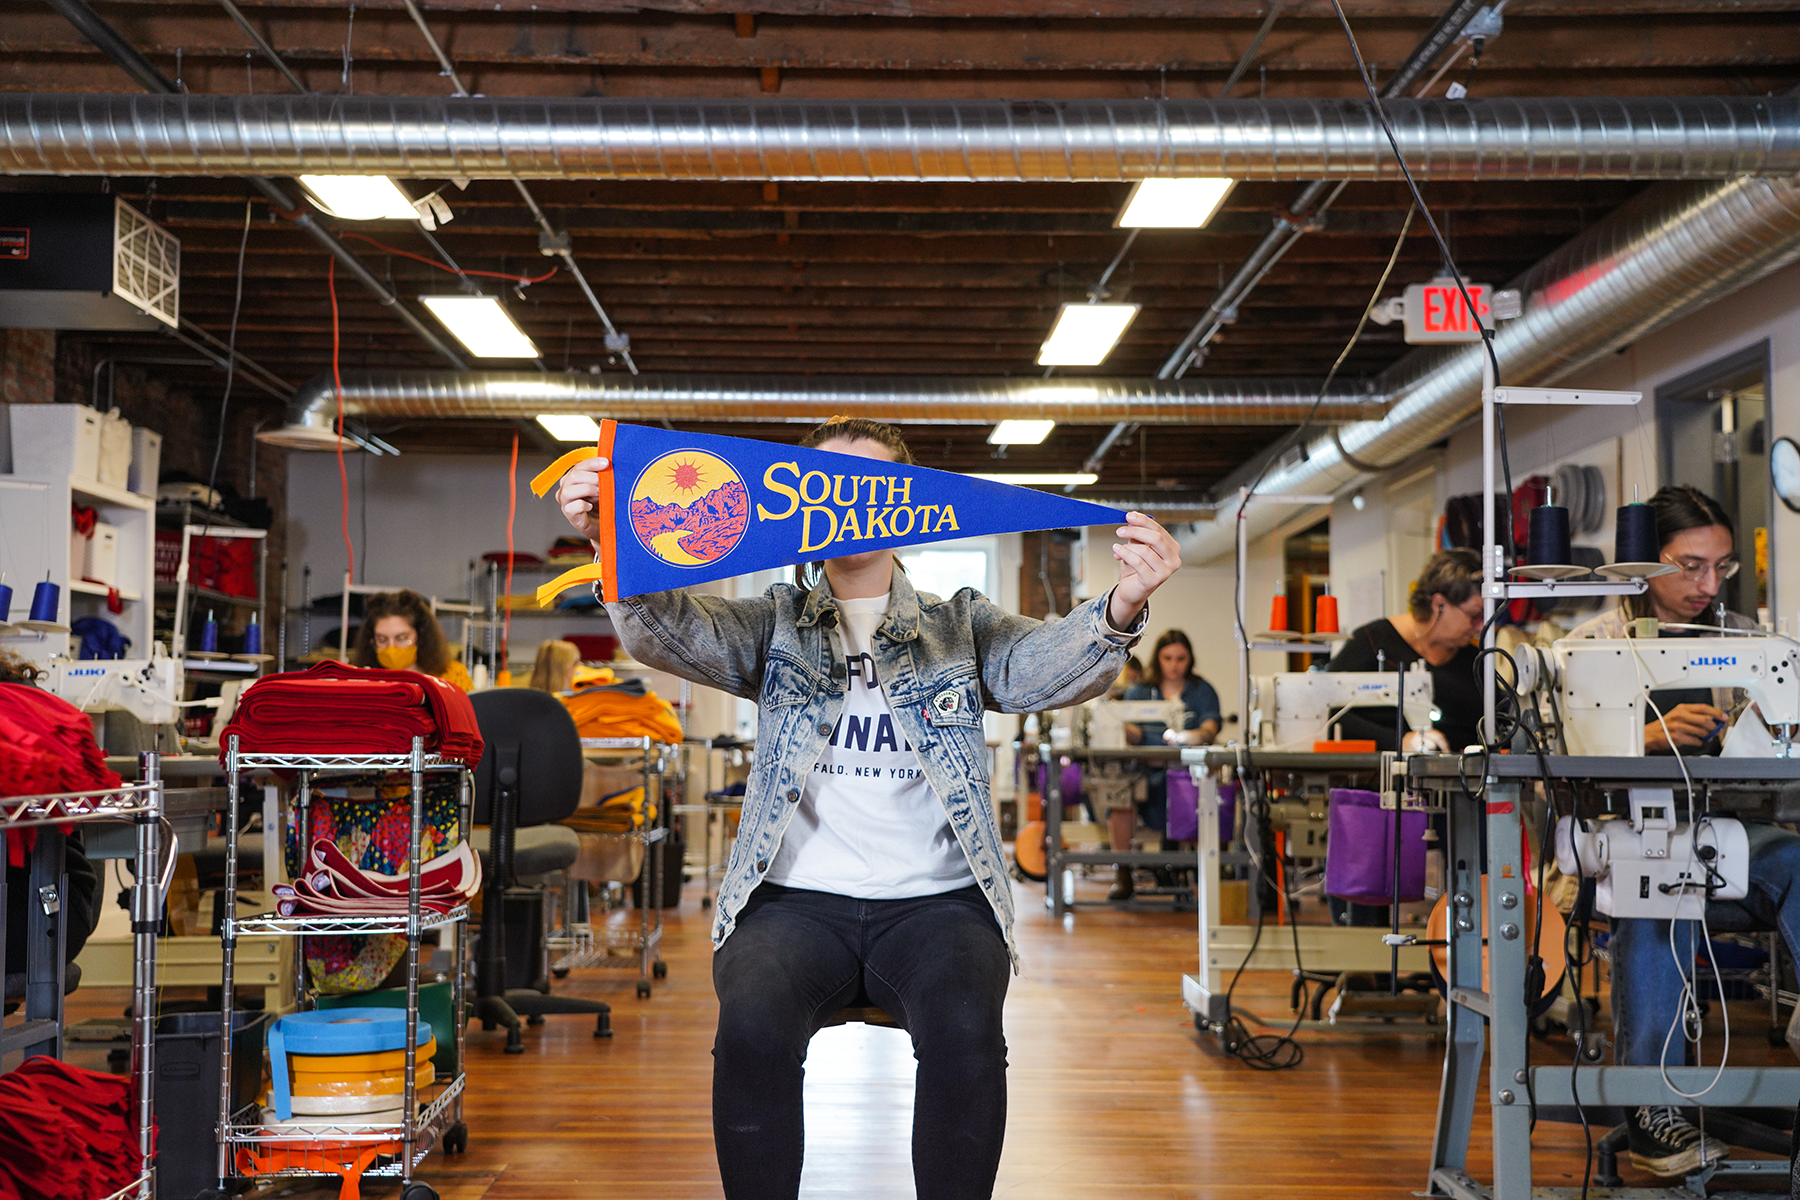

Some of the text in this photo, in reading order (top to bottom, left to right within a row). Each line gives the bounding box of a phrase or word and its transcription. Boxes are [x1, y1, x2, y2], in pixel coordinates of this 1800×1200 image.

[1423, 286, 1484, 333] EXIT
[756, 461, 913, 522] SOUTH
[797, 504, 960, 553] DAKOTA
[1690, 656, 1737, 666] JUKI
[855, 766, 881, 778] NEW
[890, 768, 922, 779] YORK
